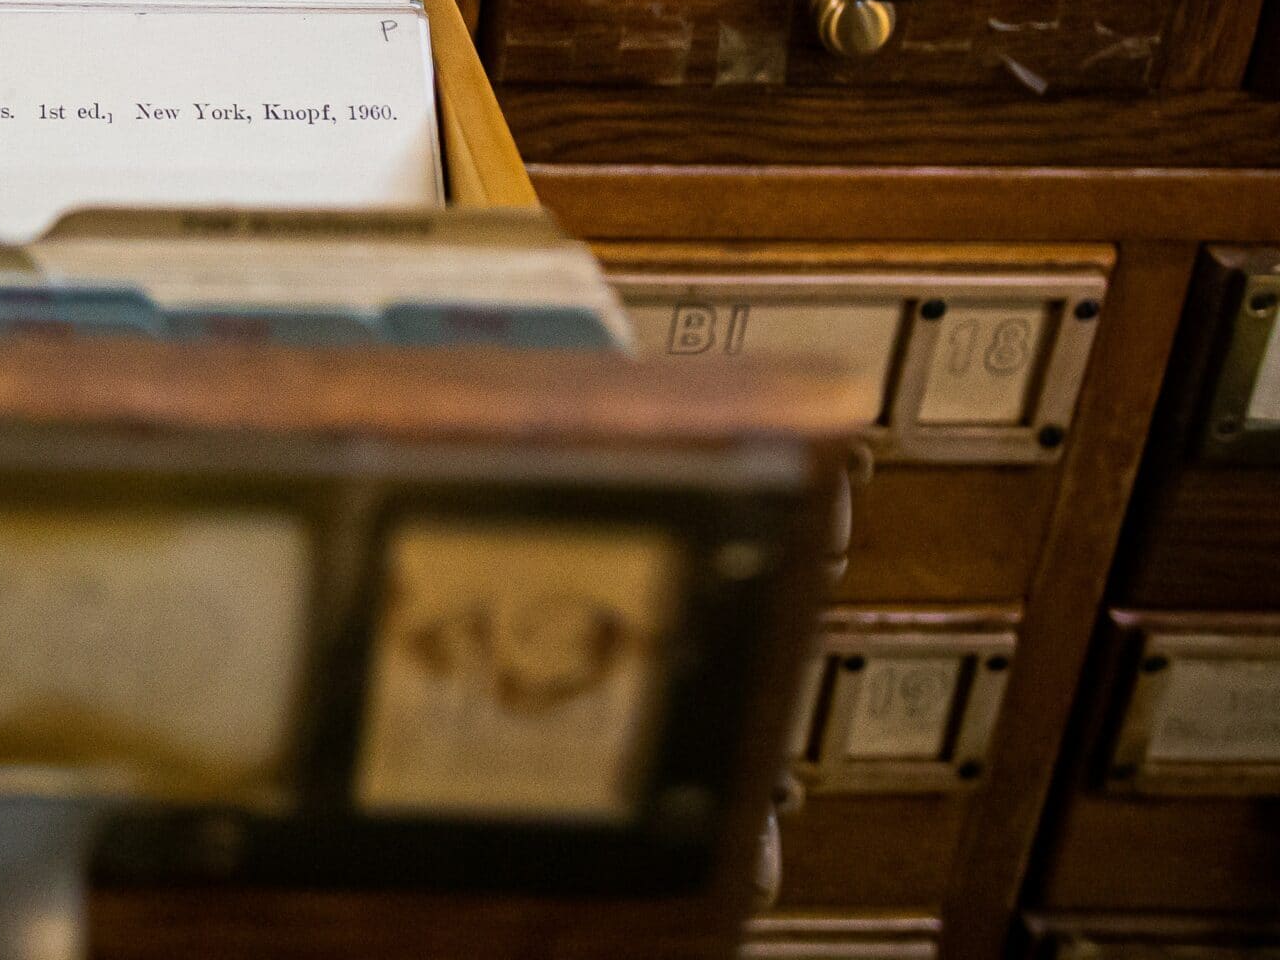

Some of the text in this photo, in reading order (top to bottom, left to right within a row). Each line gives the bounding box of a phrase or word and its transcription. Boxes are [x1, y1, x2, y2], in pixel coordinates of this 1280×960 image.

[380, 19, 399, 41] P
[38, 103, 65, 120] 1st
[135, 103, 180, 120] New
[193, 103, 252, 123] York,
[263, 103, 337, 124] Knopf,
[348, 104, 398, 121] 1960.
